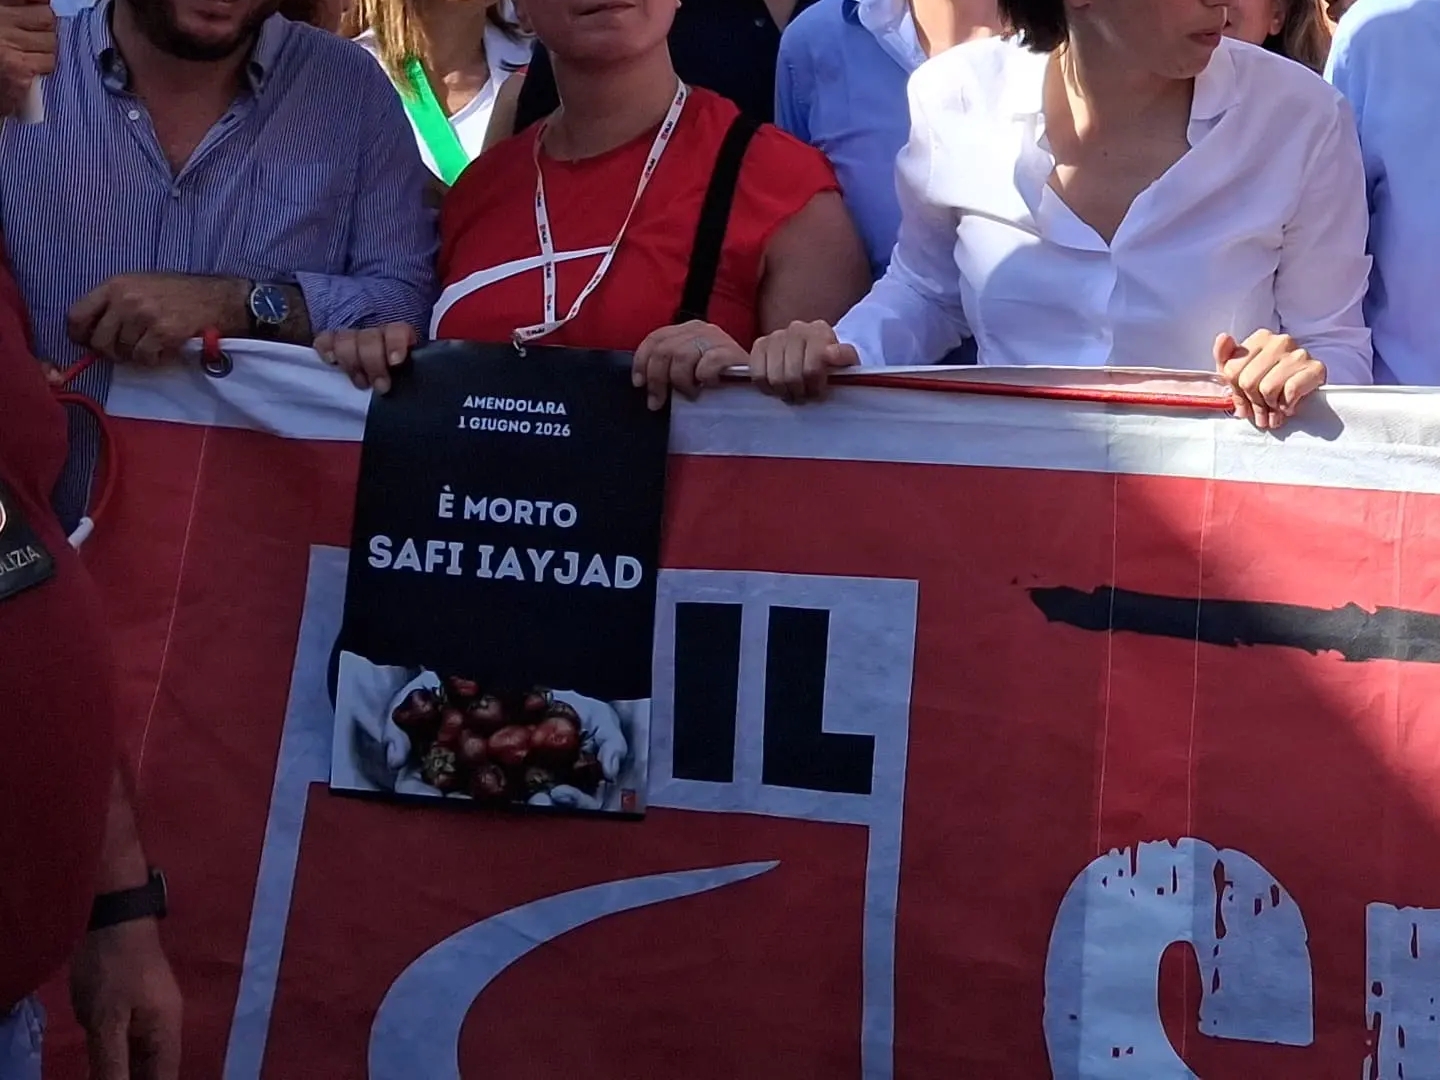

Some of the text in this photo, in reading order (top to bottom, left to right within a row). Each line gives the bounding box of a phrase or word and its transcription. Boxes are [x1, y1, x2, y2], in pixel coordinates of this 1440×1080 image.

[458, 415, 571, 437] 1 GIUGNO 2026
[462, 394, 567, 415] AMENDOLARA
[438, 484, 577, 528] È MORTO
[367, 535, 643, 589] SAFI IAYJAD
[672, 601, 876, 795] IL
